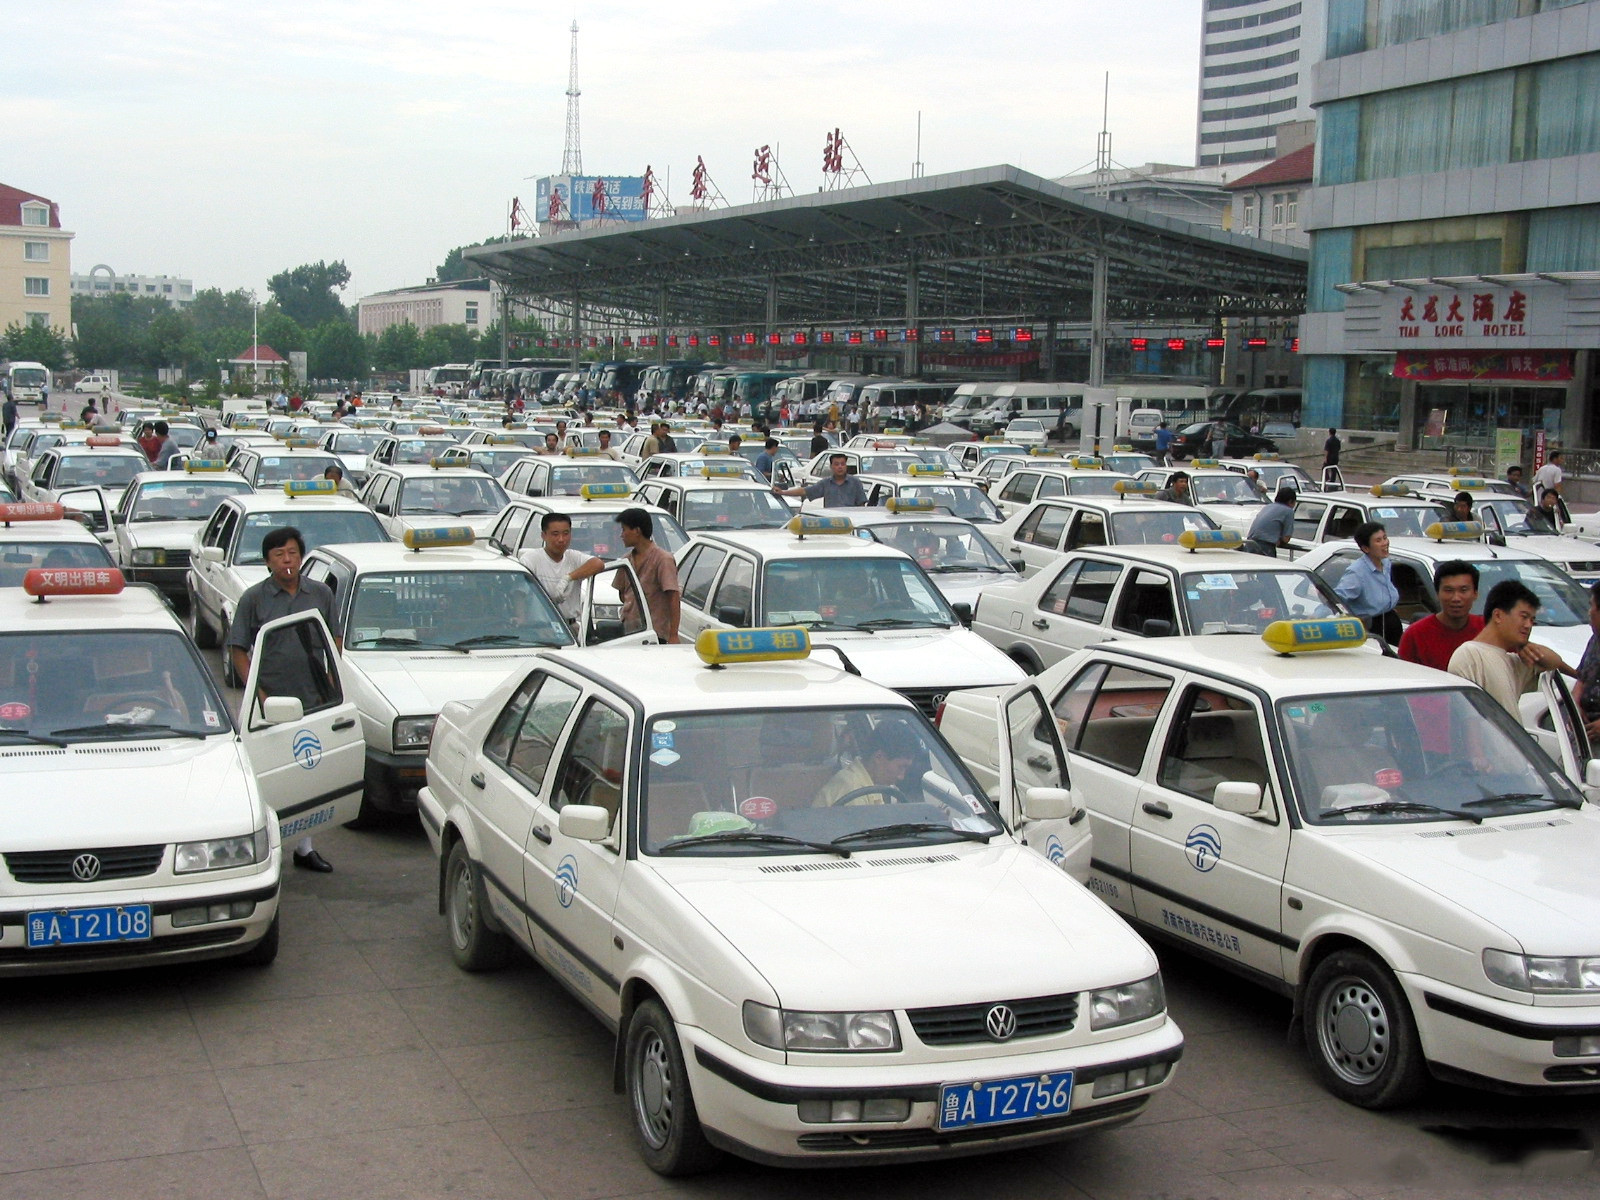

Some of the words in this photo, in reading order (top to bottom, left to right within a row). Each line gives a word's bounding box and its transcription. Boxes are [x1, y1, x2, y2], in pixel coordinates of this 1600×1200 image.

[1400, 290, 1527, 322] 天龙大酒店
[1399, 326, 1420, 338] TIAN
[1435, 325, 1464, 337] LONG
[1483, 323, 1526, 337] HOTEL
[6, 503, 55, 516] 文明出租车
[805, 518, 845, 528] 出租
[418, 528, 467, 540] 出租
[40, 571, 110, 587] 文明出租车
[727, 628, 799, 650] 出租
[1300, 623, 1358, 641] 出租
[745, 801, 773, 815] 空车
[32, 916, 62, 941] 鲁A
[70, 911, 147, 938] T2108
[944, 1089, 975, 1122] 鲁A
[987, 1078, 1067, 1117] T2756
